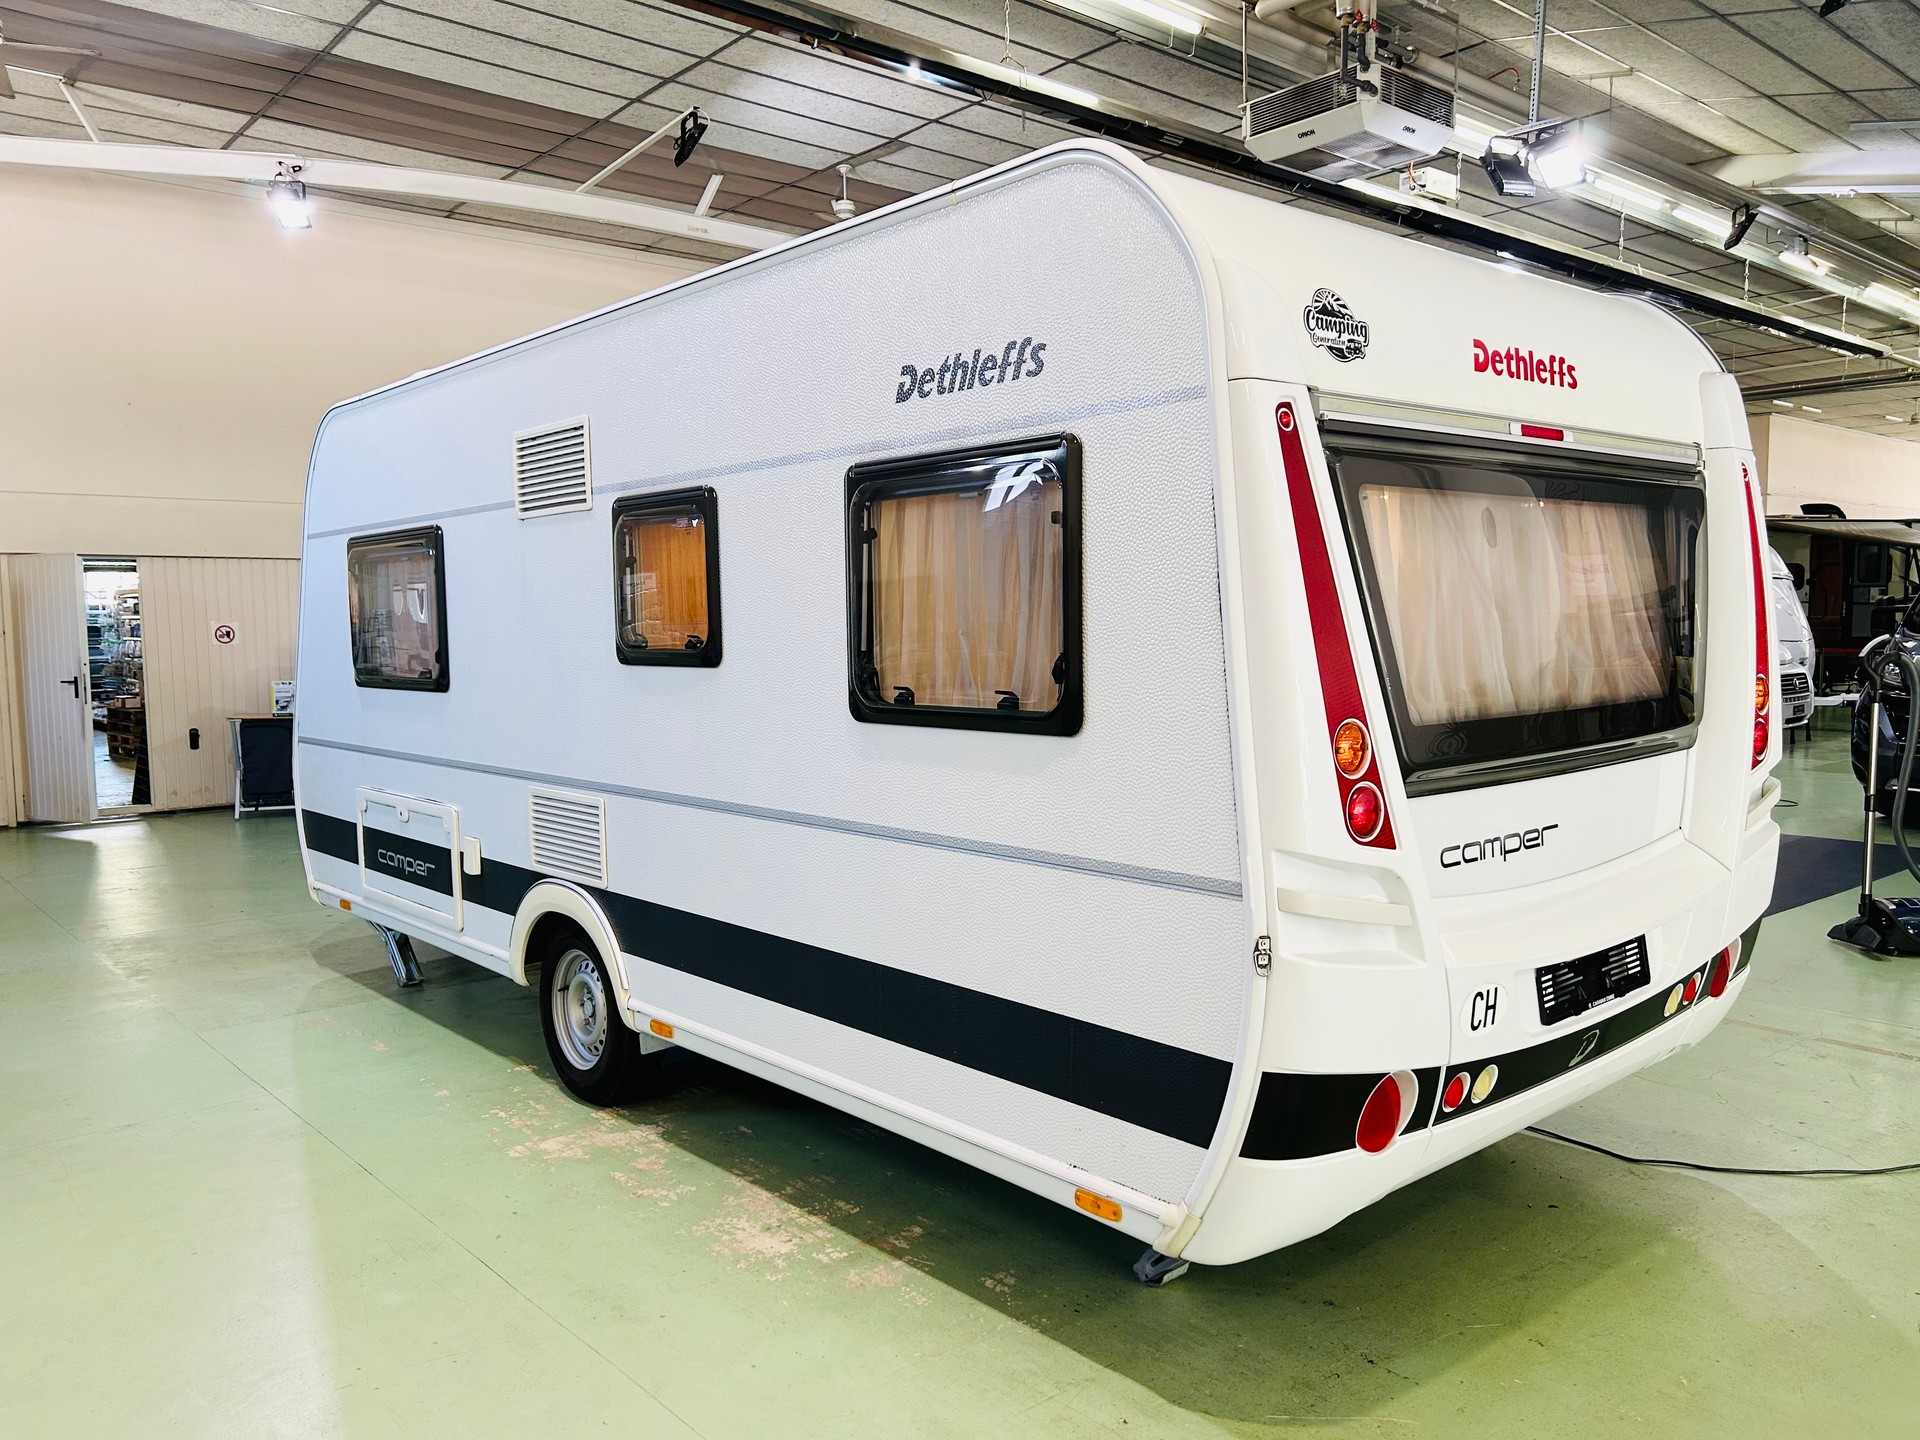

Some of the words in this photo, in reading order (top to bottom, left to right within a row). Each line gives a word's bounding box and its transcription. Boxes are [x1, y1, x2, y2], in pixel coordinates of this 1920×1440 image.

[1297, 128, 1316, 139] ORION
[1306, 308, 1368, 343] Camping
[895, 337, 1047, 404] Dethleffs
[1473, 338, 1578, 390] Dethleffs
[377, 848, 436, 876] camper
[1440, 823, 1559, 870] camper
[1470, 986, 1498, 1032] CH
